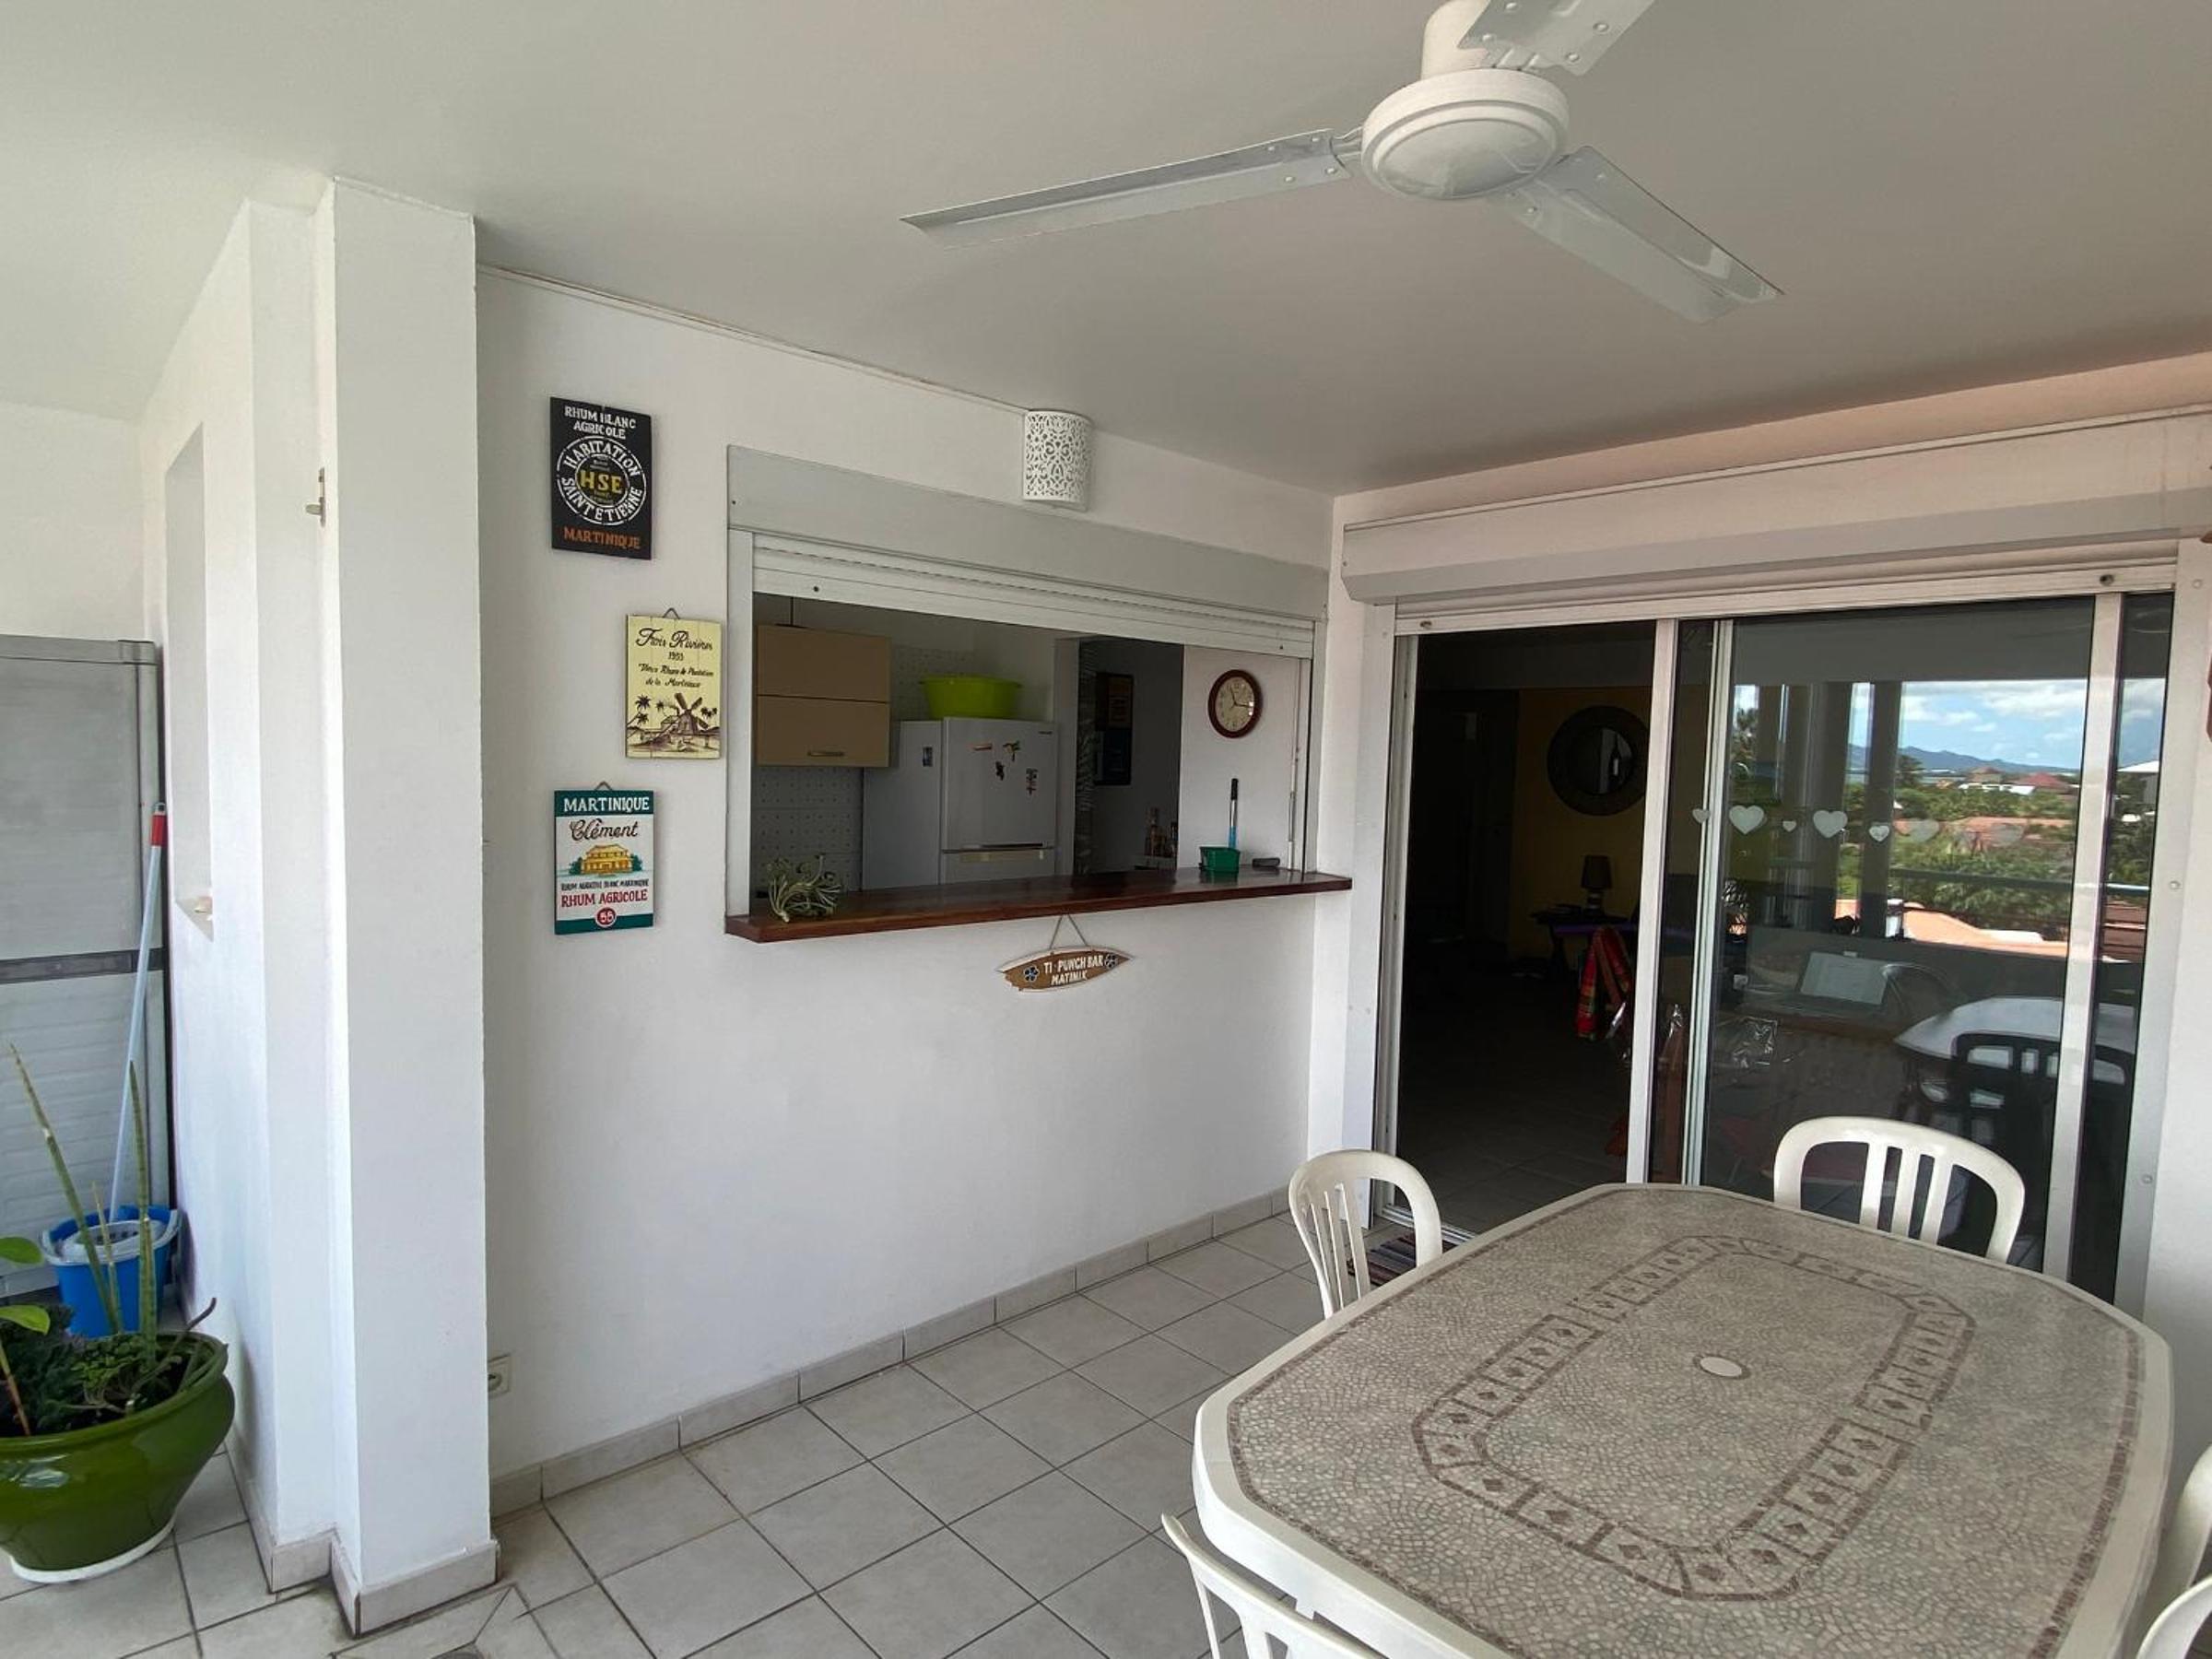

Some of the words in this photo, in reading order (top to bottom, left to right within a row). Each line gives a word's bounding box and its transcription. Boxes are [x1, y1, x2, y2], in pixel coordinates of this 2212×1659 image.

[564, 406, 598, 422] RHUM
[599, 412, 636, 429] BLANC
[573, 420, 626, 440] AGRICOLE
[563, 441, 641, 477] HABITATION
[580, 470, 622, 494] HSE
[564, 526, 641, 549] MARTINIQUE
[563, 796, 650, 813] MARTINIQUE
[561, 894, 595, 908] RHUM
[598, 888, 648, 904] AGRICOLE
[1057, 957, 1087, 973] PUNCH
[1087, 955, 1105, 969] BAR
[1051, 971, 1087, 985] MATINIK
